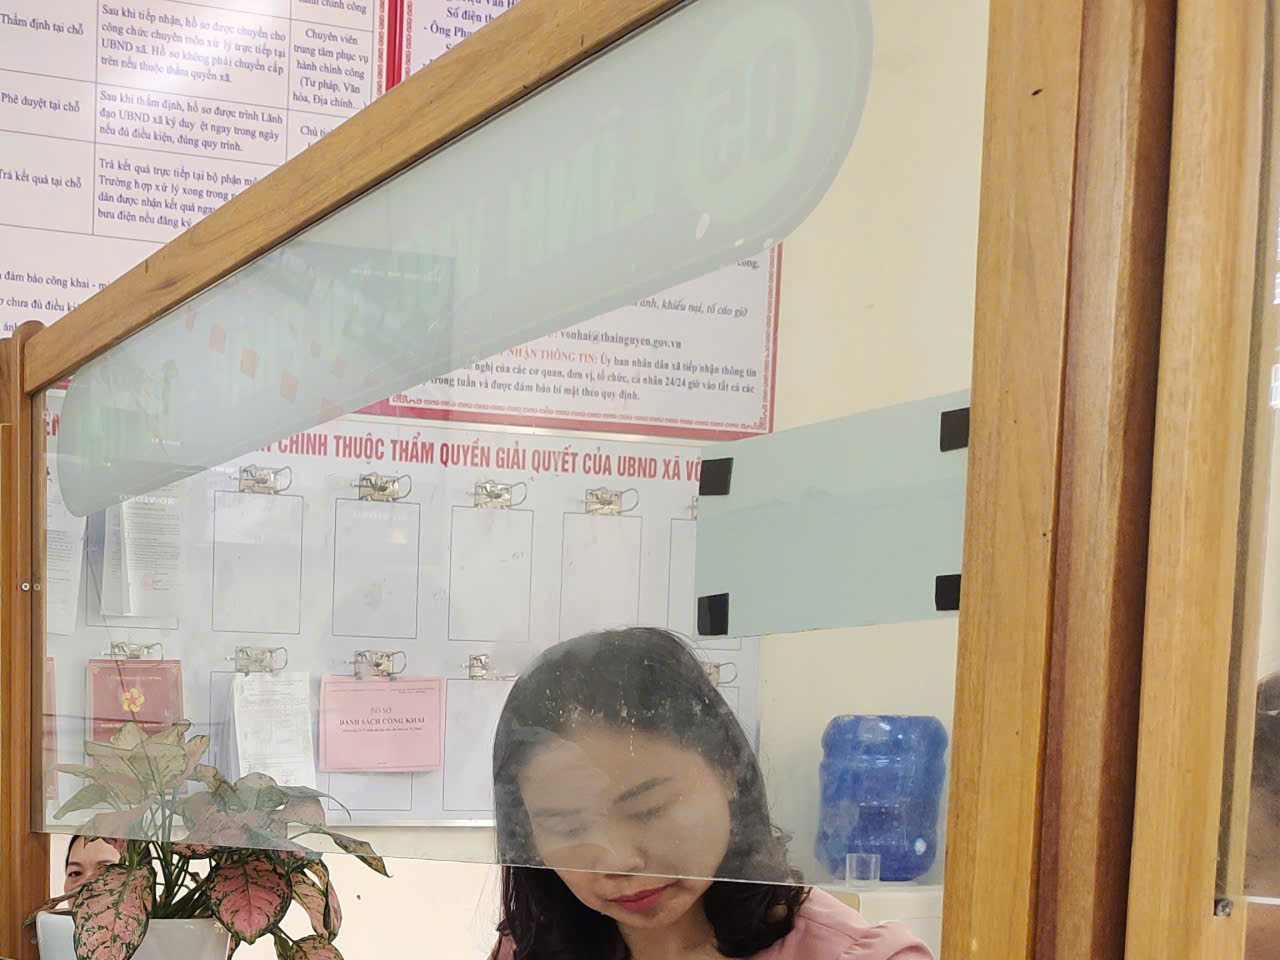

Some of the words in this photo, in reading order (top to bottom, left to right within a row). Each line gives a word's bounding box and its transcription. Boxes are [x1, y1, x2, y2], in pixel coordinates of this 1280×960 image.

[347, 2, 367, 15] công
[447, 7, 460, 18] Số
[462, 10, 482, 23] điện
[0, 13, 27, 27] Thẩm
[29, 18, 50, 31] định
[53, 23, 64, 33] tại
[67, 23, 84, 35] chỗ
[102, 4, 119, 17] Sau
[121, 7, 136, 19] khi
[139, 8, 156, 24] tiếp
[270, 30, 286, 41] cho
[430, 20, 451, 37] Ông
[101, 38, 133, 52] UBND
[305, 28, 338, 43] Chuyên
[340, 33, 359, 46] viên
[274, 46, 286, 59] tại
[293, 43, 316, 57] trung
[318, 46, 334, 58] tâm
[336, 49, 356, 64] phục
[358, 54, 369, 65] vụ
[296, 59, 317, 73] hành
[319, 62, 343, 76] chính
[345, 66, 365, 80] công
[0, 91, 19, 105] Phê
[21, 95, 47, 110] duyệt
[49, 101, 60, 111] tại
[63, 101, 80, 113] chỗ
[161, 98, 185, 112] định,
[187, 100, 199, 113] hồ
[202, 105, 212, 115] sơ
[214, 103, 236, 119] được
[238, 108, 259, 121] trình
[261, 111, 283, 125] Lãnh
[100, 107, 117, 120] đạo
[119, 109, 150, 123] UBND
[152, 112, 163, 124] xã
[210, 123, 231, 136] ngay
[234, 125, 257, 139] trong
[258, 127, 280, 143] ngày
[201, 138, 218, 152] quy
[15, 168, 30, 182] kết
[51, 176, 62, 188] tại
[65, 176, 82, 189] chỗ
[118, 157, 131, 172] kết
[153, 165, 171, 177] trực
[174, 167, 190, 180] tiếp
[193, 169, 204, 181] tại
[207, 171, 218, 183] bộ
[141, 197, 162, 209] nhận
[183, 188, 204, 198] xong
[206, 189, 228, 201] trong
[117, 210, 137, 223] điện
[4, 271, 25, 282] đảm
[27, 272, 44, 285] bảo
[46, 275, 68, 289] công
[70, 277, 90, 289] khai
[6, 297, 29, 309] chưa
[31, 298, 43, 310] đủ
[45, 300, 65, 312] điều
[661, 297, 686, 311] khiếu
[614, 355, 630, 367] ban
[746, 367, 757, 377] tin
[664, 375, 686, 388] 24/24
[333, 432, 385, 462] THUỘC
[390, 432, 435, 465] THẨM
[438, 437, 491, 470] QUYỀN
[495, 439, 526, 470] GIẢI
[531, 444, 579, 474] QUYẾT
[582, 444, 613, 476] CỦA
[617, 454, 658, 479] UBND
[662, 455, 681, 481] XÃ
[362, 717, 380, 725] SÁCH
